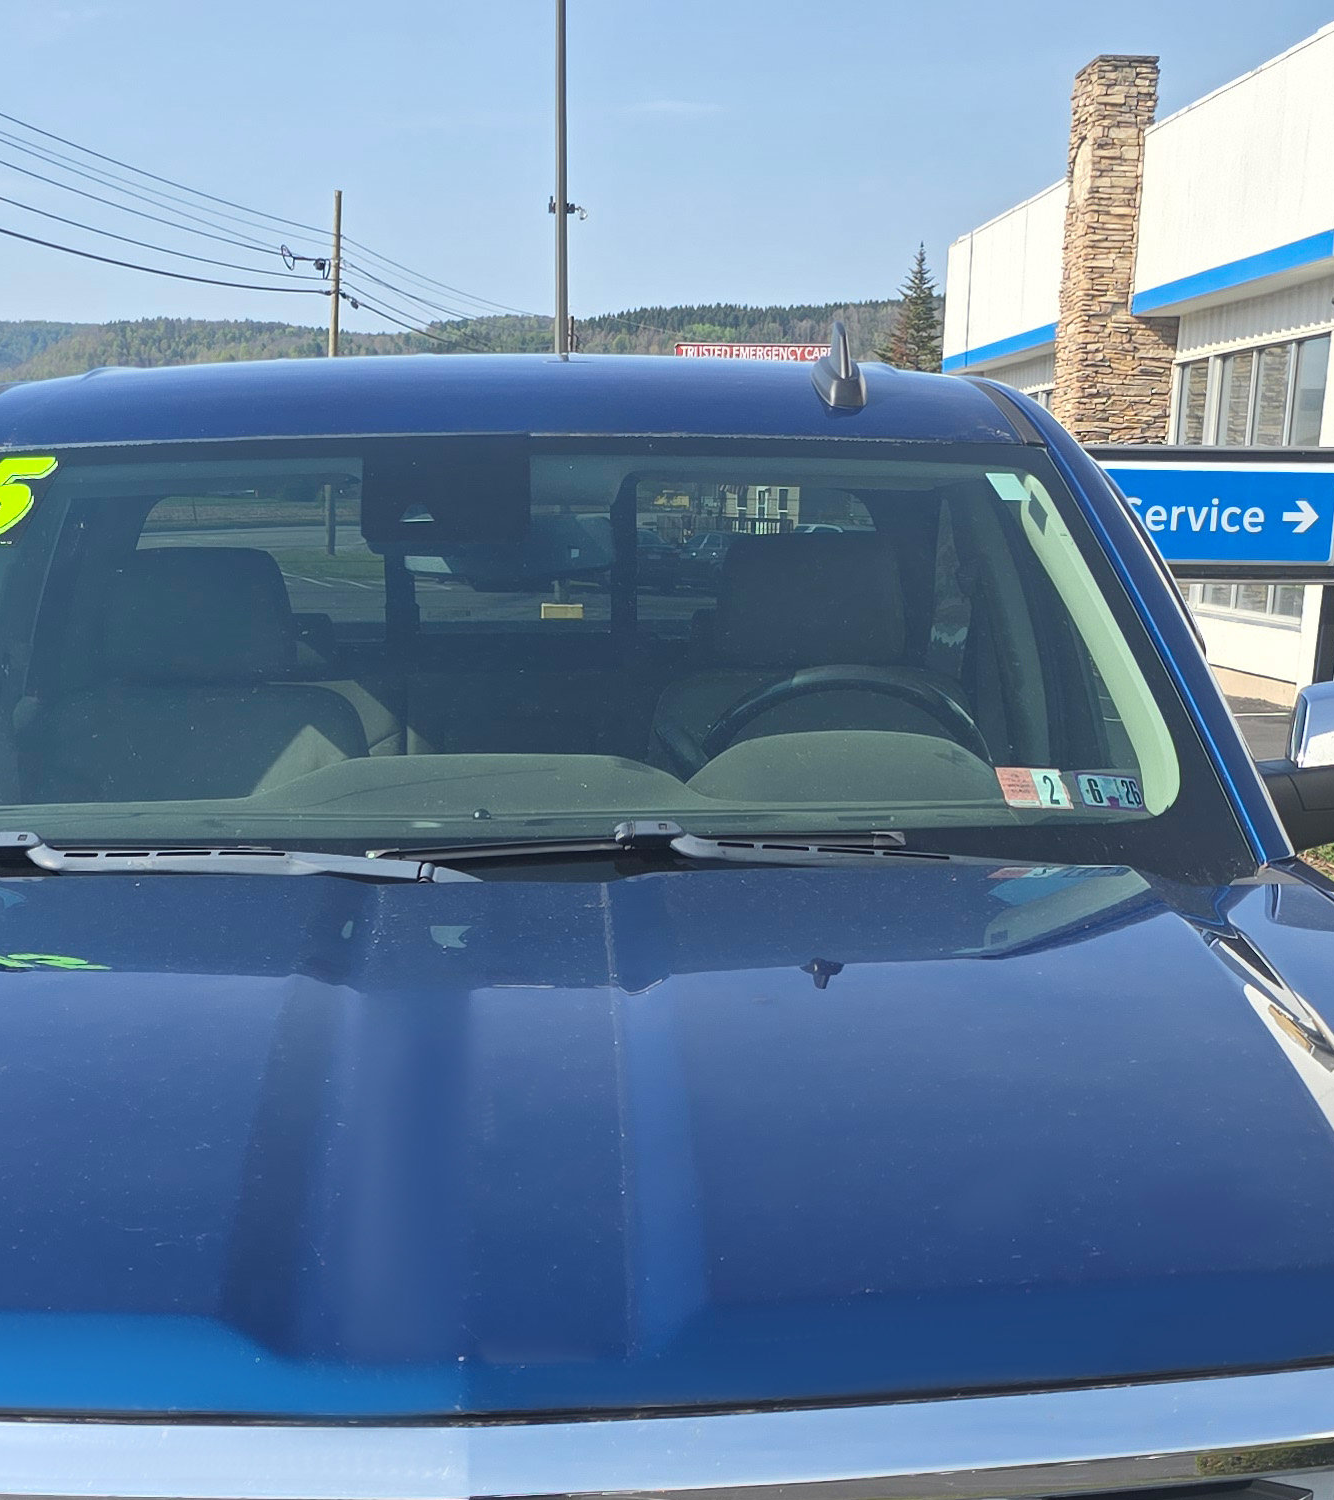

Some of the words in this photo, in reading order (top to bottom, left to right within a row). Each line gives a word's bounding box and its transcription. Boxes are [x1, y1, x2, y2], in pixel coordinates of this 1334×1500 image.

[680, 345, 731, 359] TRUSTED
[732, 346, 803, 361] EMERGENCY
[1126, 497, 1265, 533] Service
[1043, 775, 1060, 805] 2
